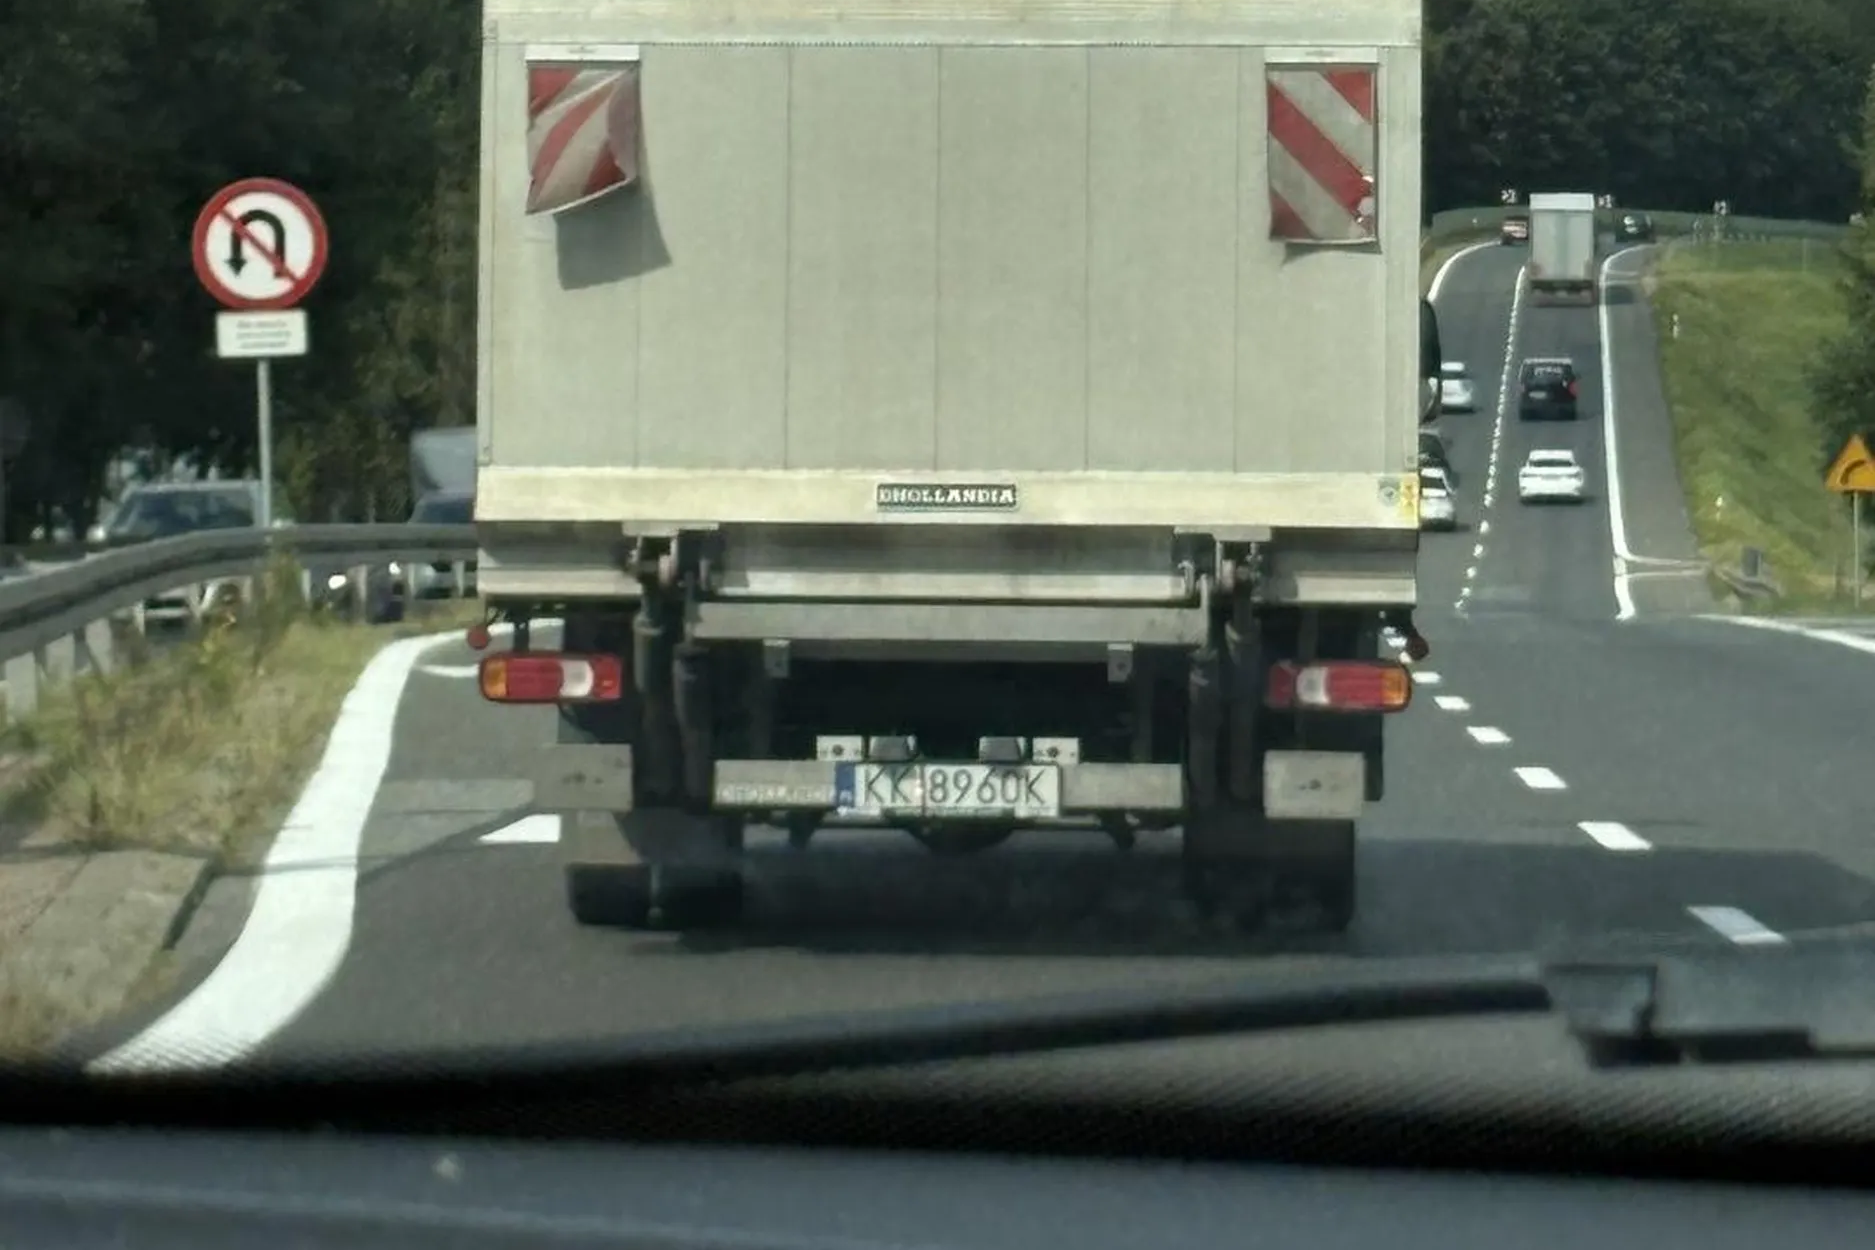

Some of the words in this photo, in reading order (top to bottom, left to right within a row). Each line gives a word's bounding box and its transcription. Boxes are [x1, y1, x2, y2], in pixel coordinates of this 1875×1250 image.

[878, 487, 1014, 503] DHOLLANDIA
[864, 763, 912, 803] KK
[929, 766, 1046, 804] 8960K
